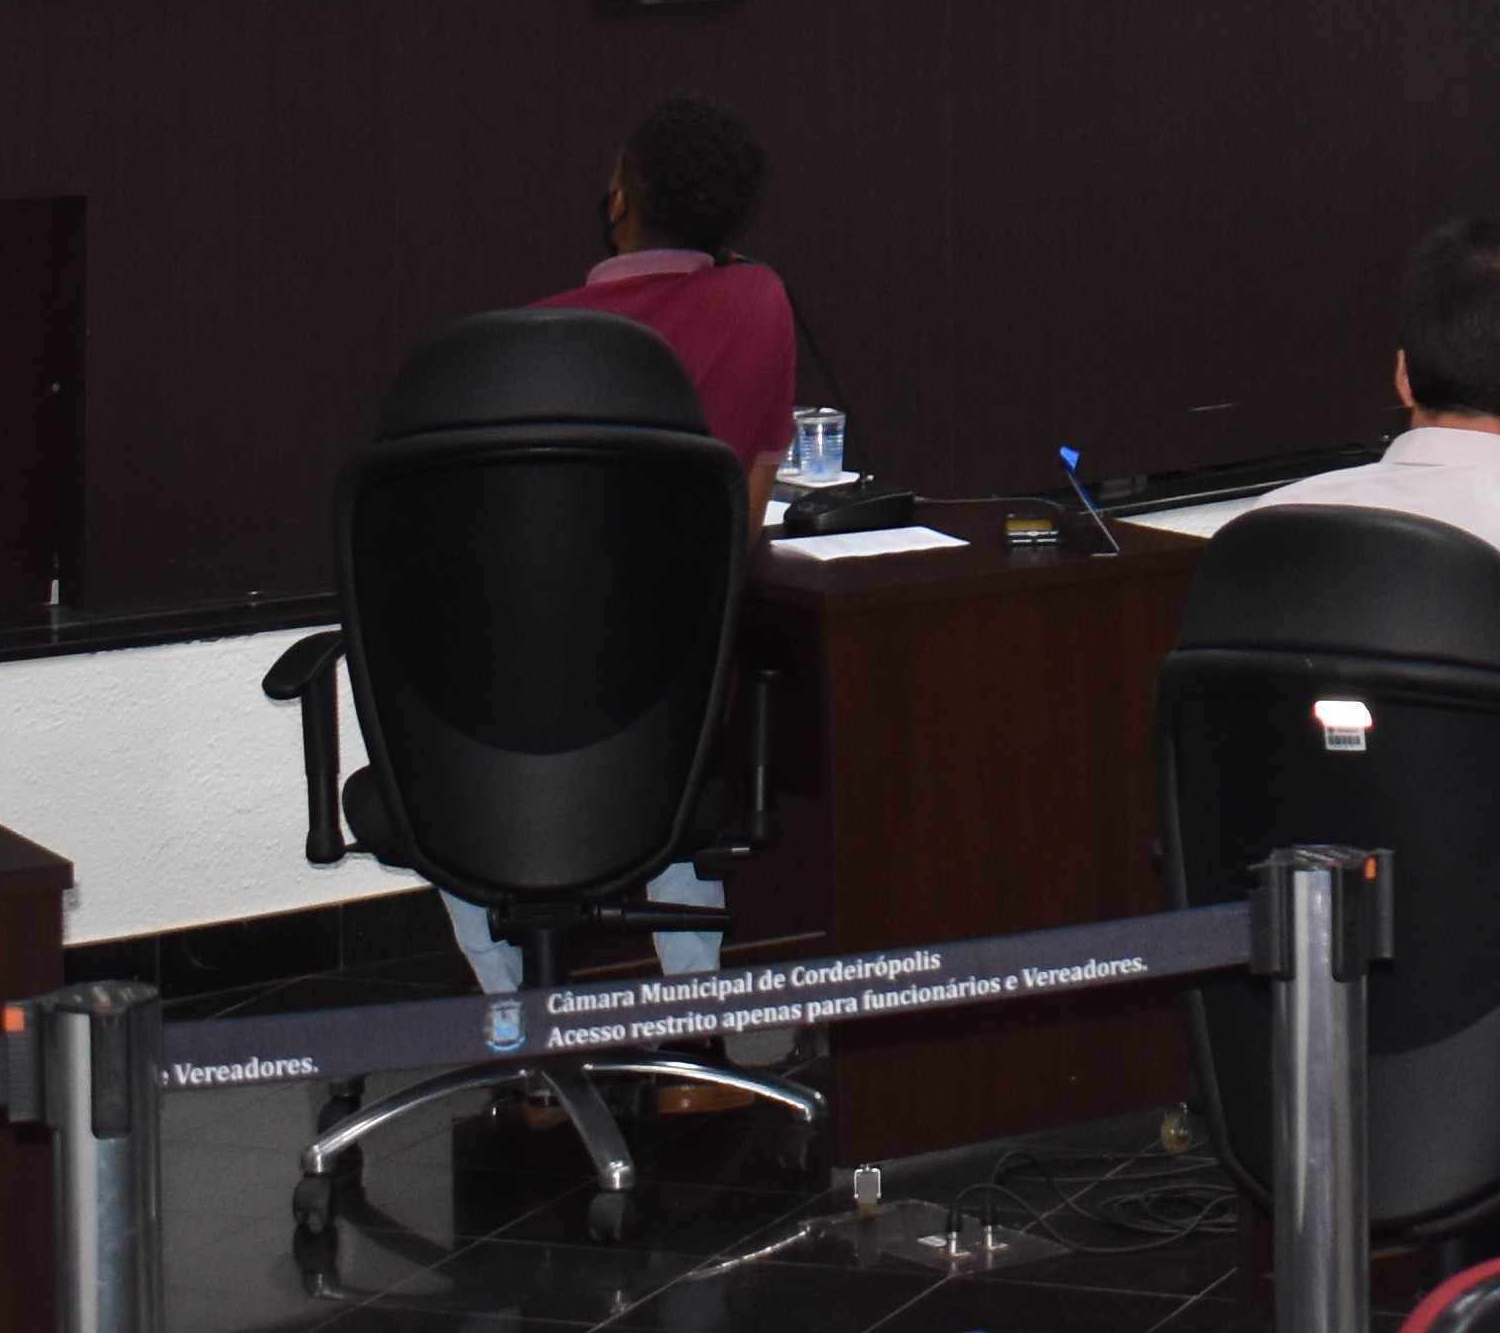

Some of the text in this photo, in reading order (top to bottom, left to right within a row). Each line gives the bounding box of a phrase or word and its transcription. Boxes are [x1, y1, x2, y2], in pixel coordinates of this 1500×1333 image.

[547, 949, 942, 1015] Câmara Municipal de Cordeirópolis
[547, 954, 1149, 1049] Acesso restrito apenas para funcionários e Vereadores.
[173, 1055, 319, 1086] Vereadores.
